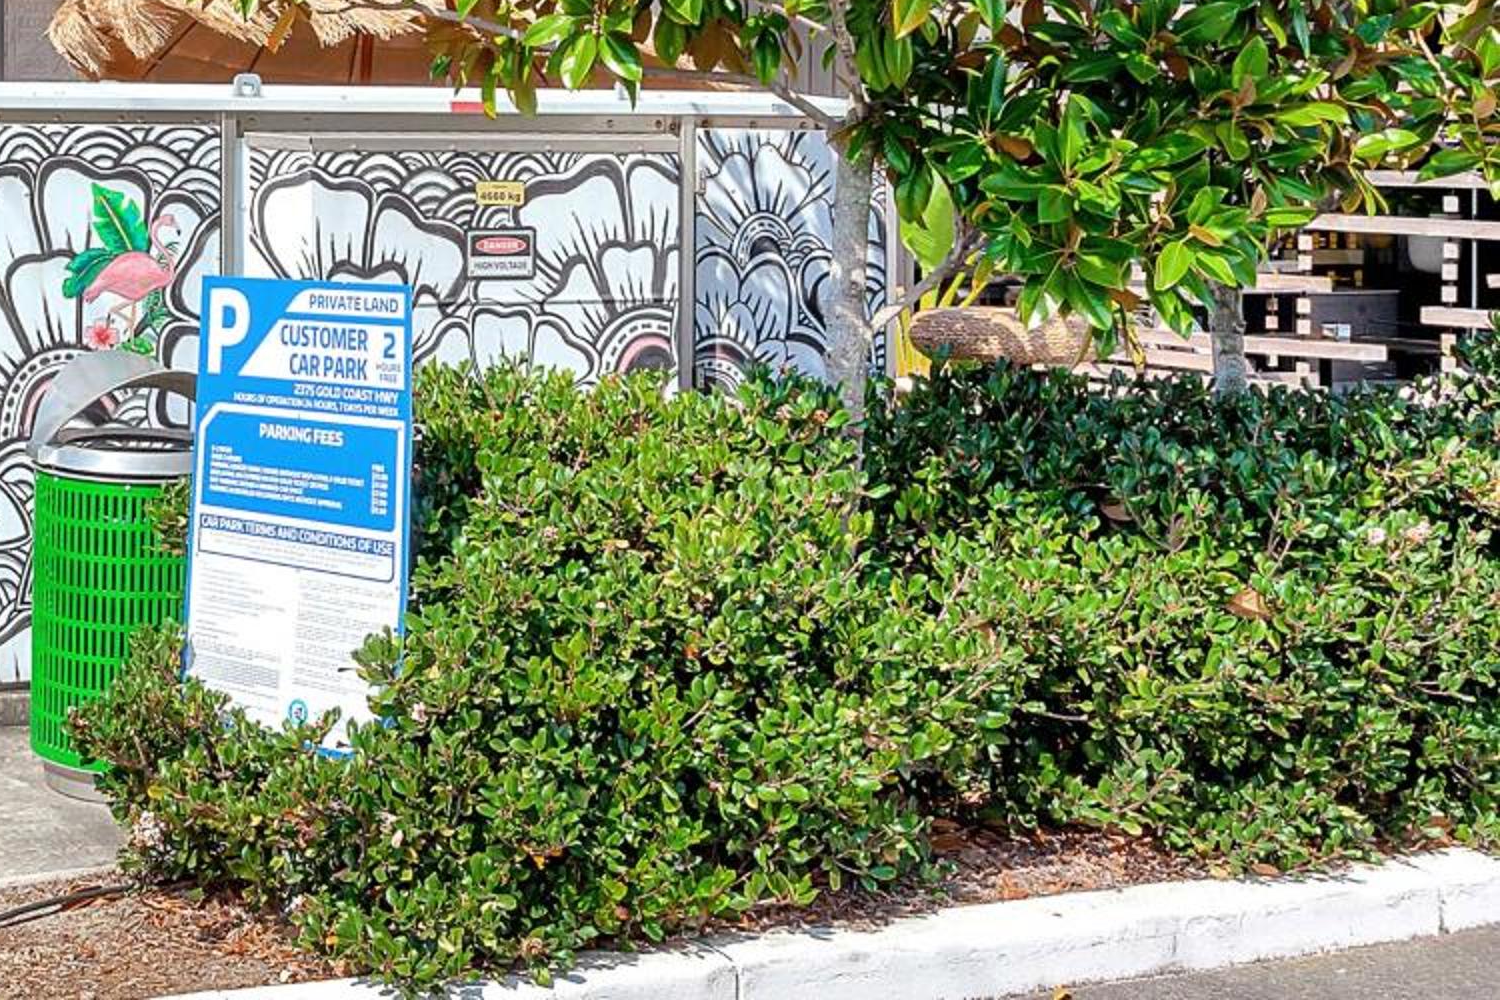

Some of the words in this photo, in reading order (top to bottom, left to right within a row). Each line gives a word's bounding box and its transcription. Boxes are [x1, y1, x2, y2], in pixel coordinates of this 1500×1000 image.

[494, 261, 528, 270] VOLTAGE
[309, 293, 362, 311] PRIVATE
[364, 297, 399, 313] LAND
[208, 287, 250, 375] P
[281, 324, 369, 352] CUSTOMER
[383, 332, 396, 359] 2
[290, 353, 320, 377] CAR
[323, 355, 369, 381] PARK
[343, 386, 373, 402] COAST
[374, 390, 400, 405] HWY
[260, 423, 312, 444] PARKING
[314, 429, 343, 447] FEES
[202, 515, 219, 530] CAR
[220, 518, 244, 533] PARK
[245, 521, 276, 537] TERMS
[278, 526, 298, 541] AND
[299, 529, 357, 550] CONDITIONS
[358, 539, 372, 552] OF
[373, 541, 394, 555] USE
